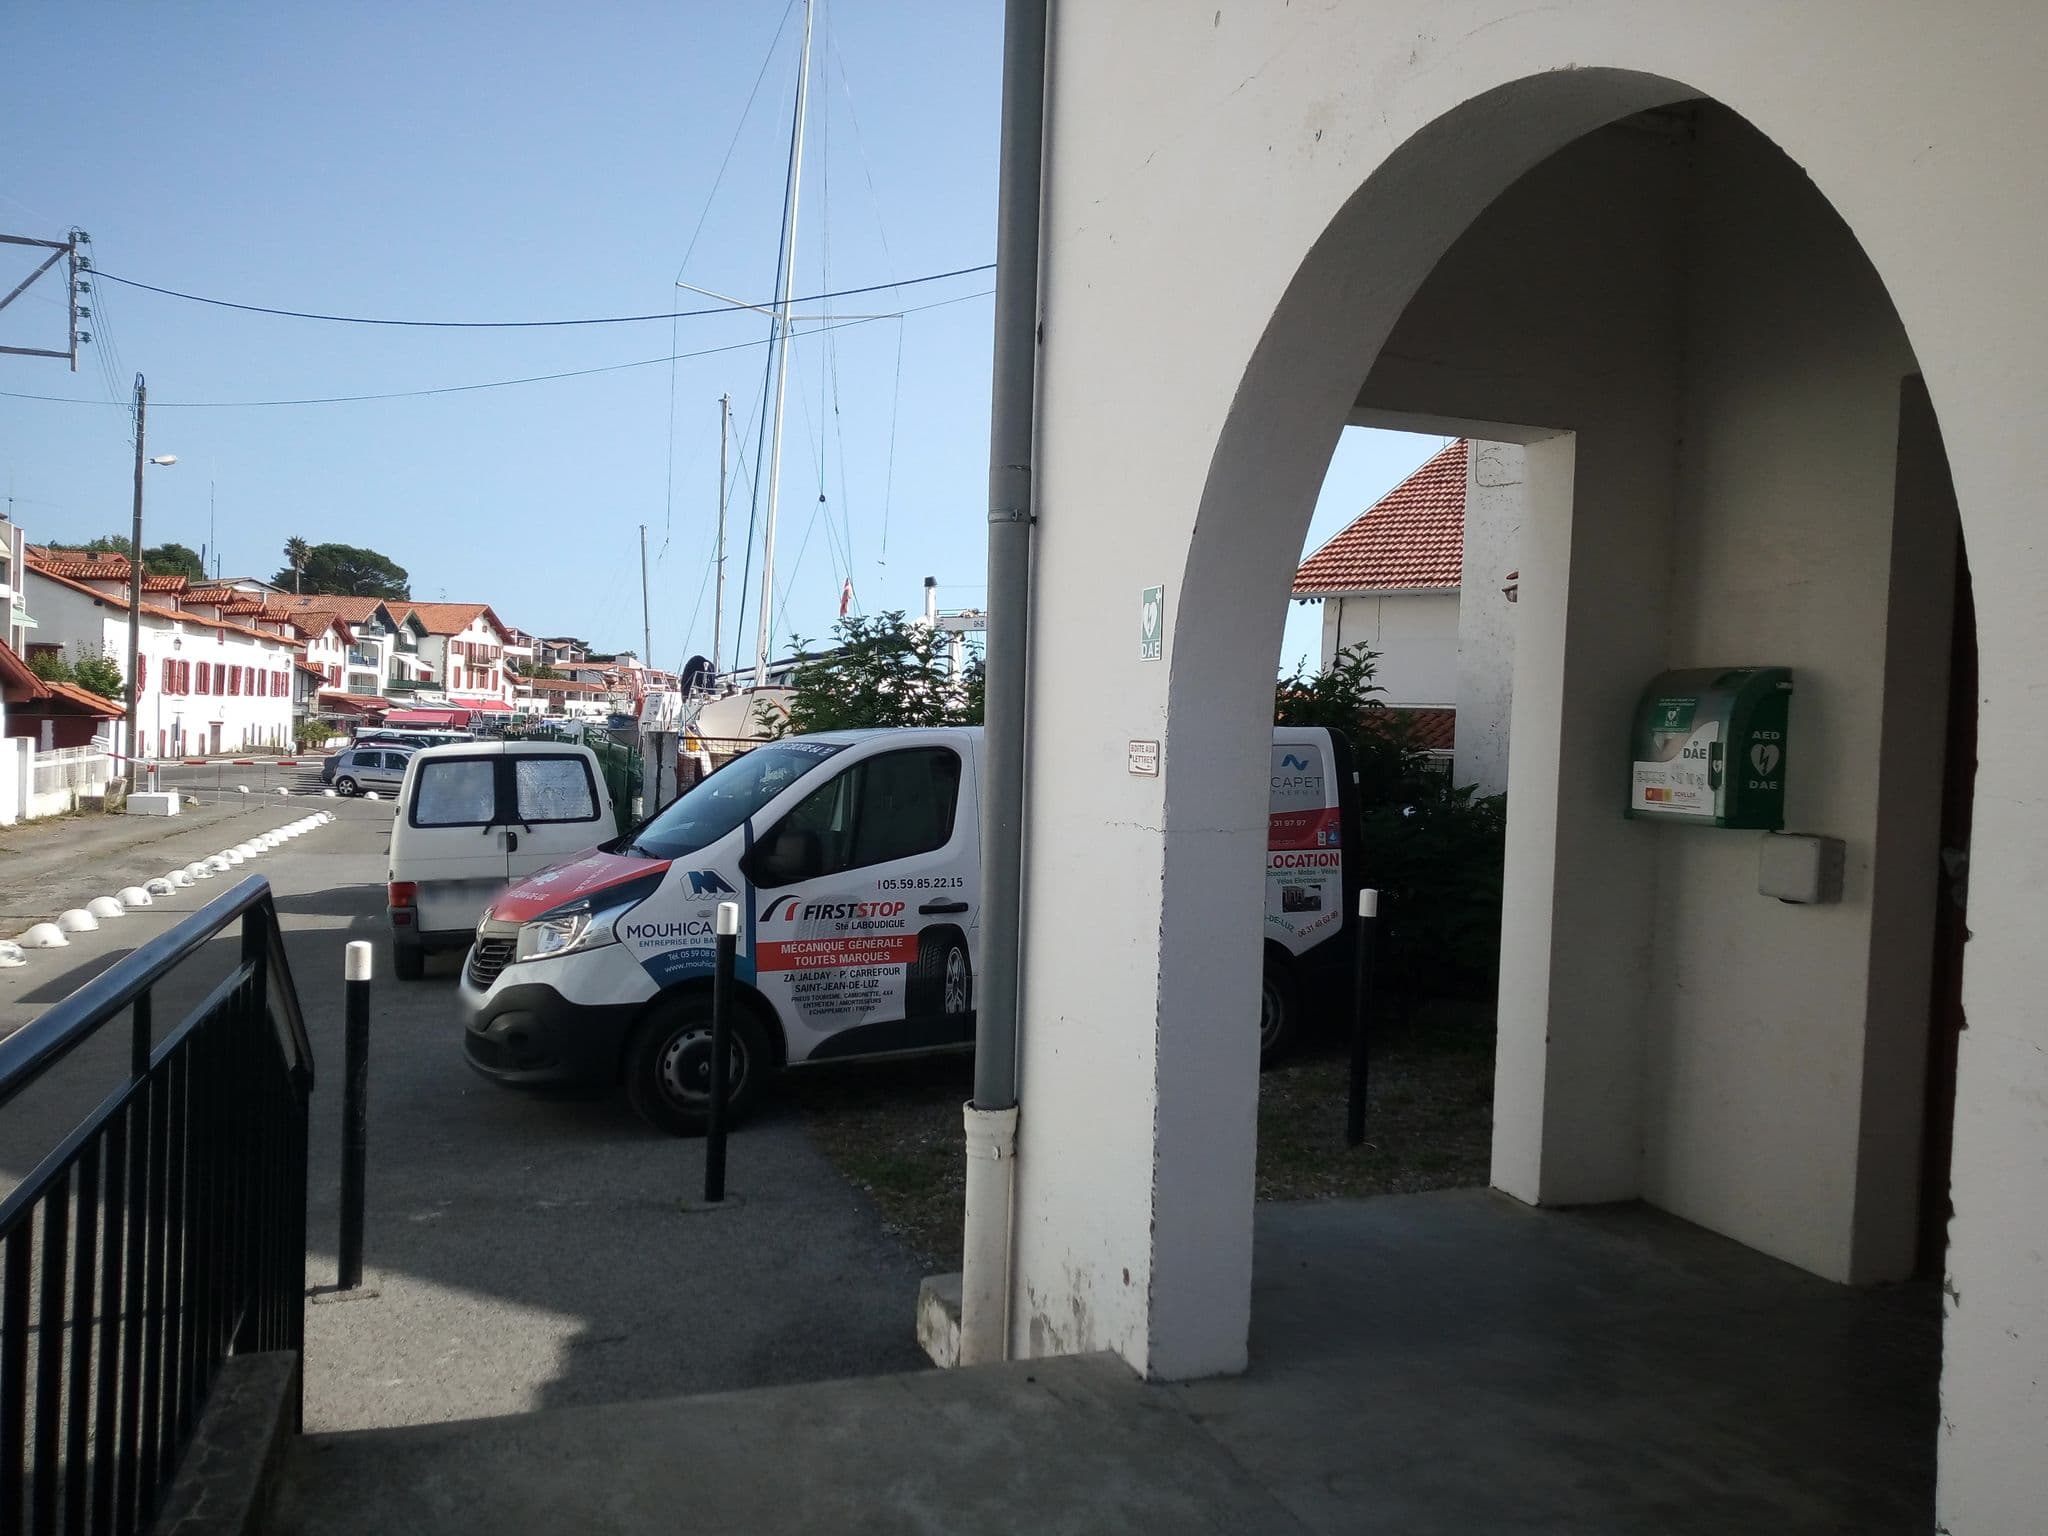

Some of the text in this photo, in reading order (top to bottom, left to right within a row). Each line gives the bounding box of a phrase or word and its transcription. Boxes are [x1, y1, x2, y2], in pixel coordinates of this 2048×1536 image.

[1142, 641, 1160, 658] DAE
[1752, 730, 1780, 740] AED
[1133, 755, 1153, 764] LETTRES
[1683, 748, 1707, 760] DAE
[1749, 781, 1777, 790] DAE
[883, 877, 964, 891] 05.59.85.22.15
[851, 919, 905, 930] LABOUDIGUE
[639, 938, 689, 949] ENTREPRISE
[690, 937, 702, 945] DU
[781, 936, 904, 955] MÉCANIQUE GÉNÉRALE
[794, 951, 890, 967] TOUTES MARQUES
[784, 973, 796, 983] ZA
[798, 970, 831, 982] JALDAY
[849, 966, 901, 979] CARREFOUR
[795, 979, 880, 993] SAINT-JEAN-DE-LUZ
